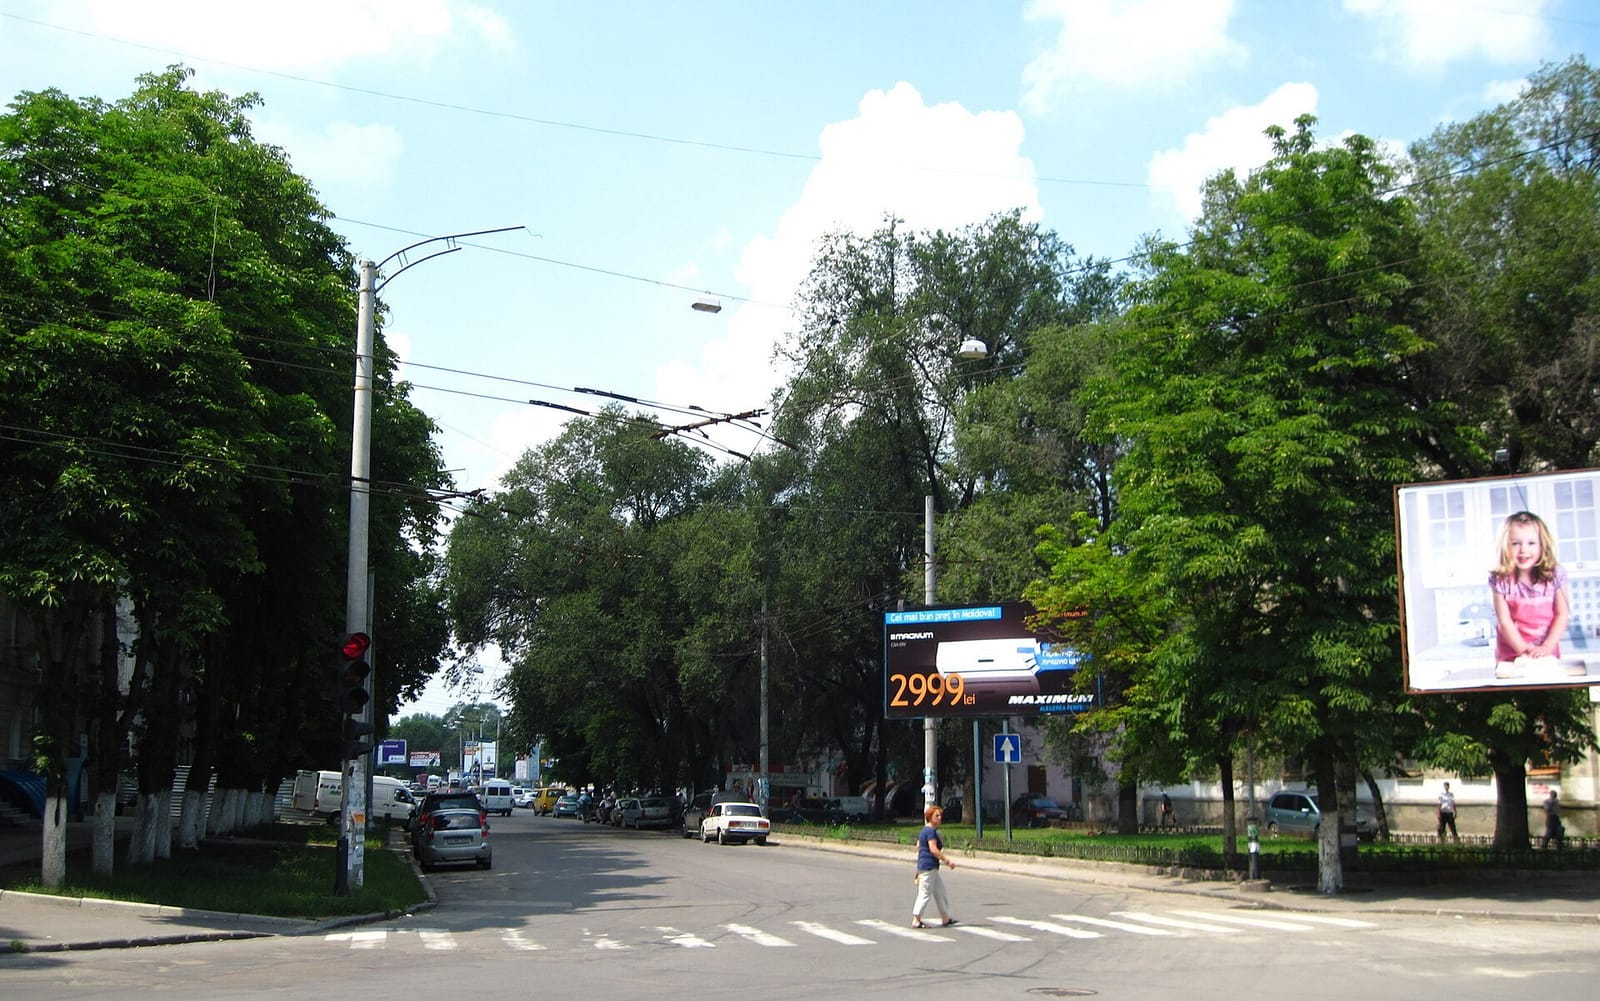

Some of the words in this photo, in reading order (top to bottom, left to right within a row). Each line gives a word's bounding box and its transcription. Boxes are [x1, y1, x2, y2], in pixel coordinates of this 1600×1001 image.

[890, 613, 903, 622] Cel
[904, 612, 918, 621] mai
[919, 612, 934, 621] bun
[961, 607, 995, 618] Moldova!
[895, 631, 934, 640] MAGNUM
[890, 672, 965, 707] 2999
[963, 693, 976, 705] lei
[1008, 694, 1094, 705] MAXIMUM
